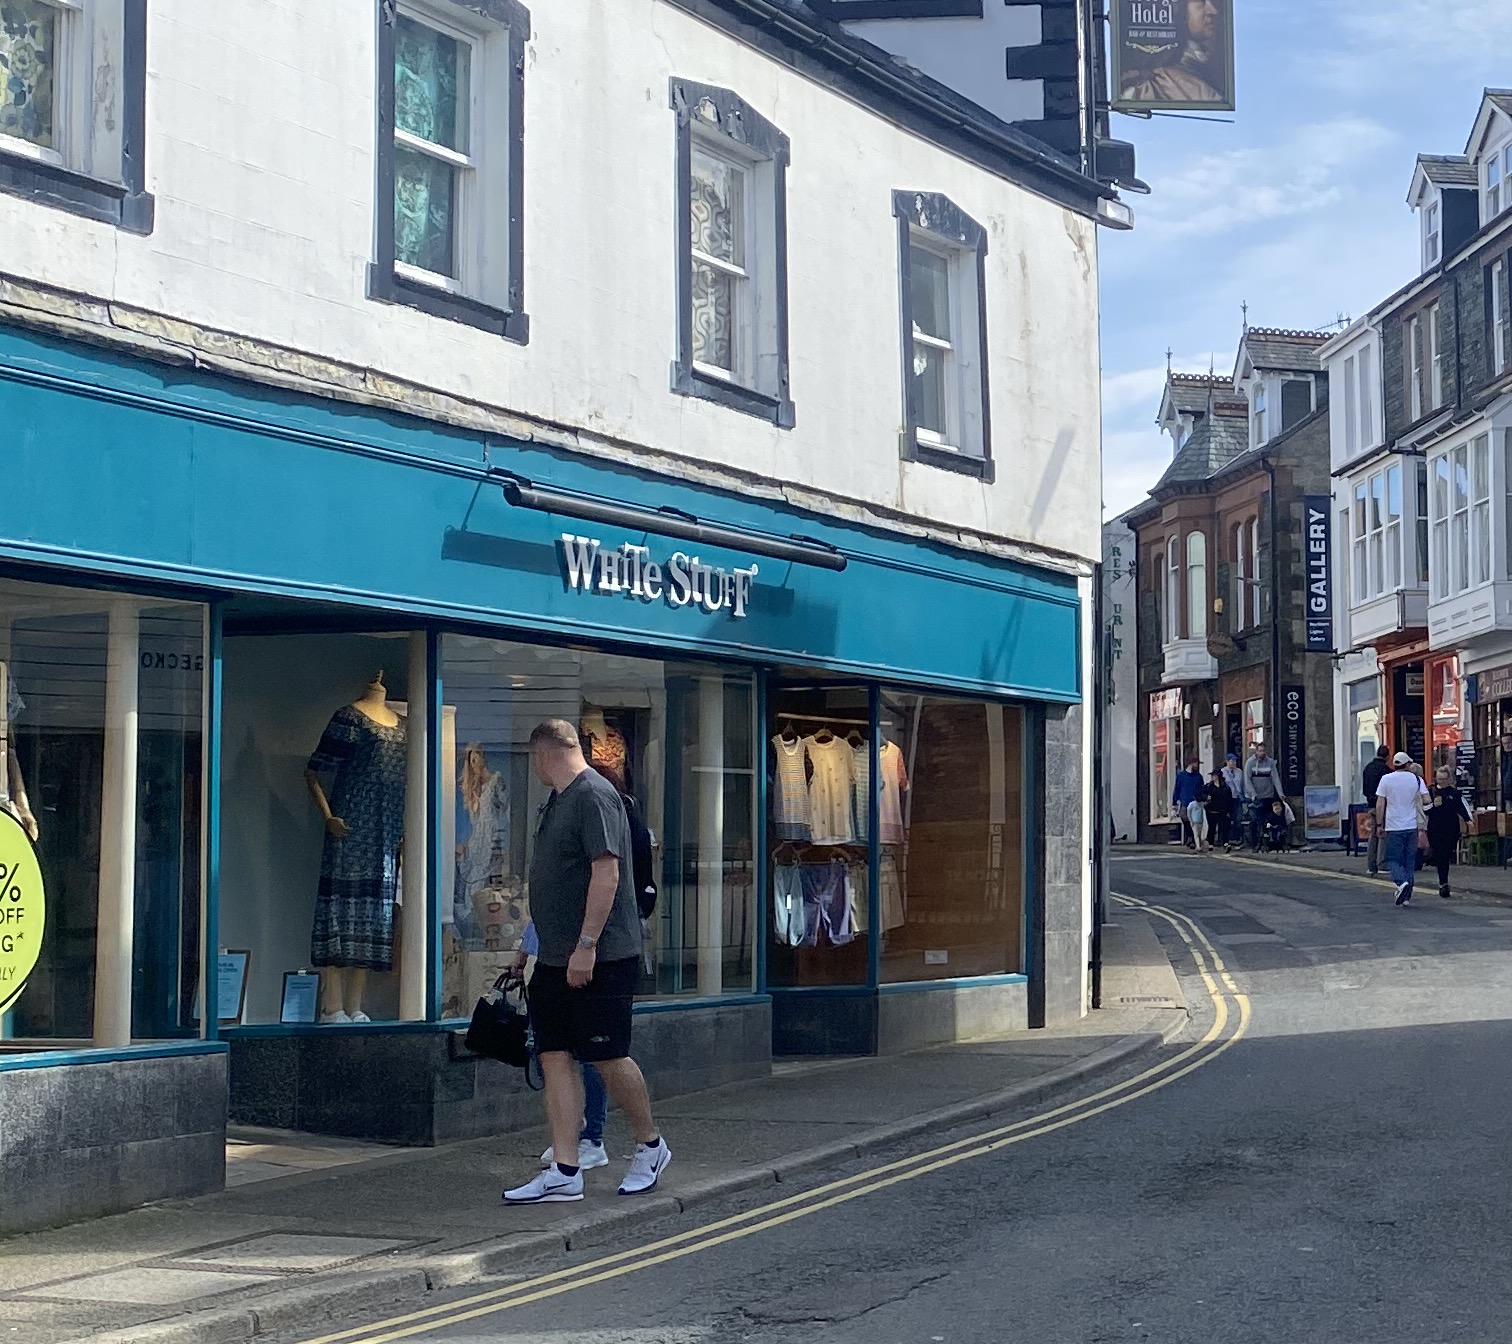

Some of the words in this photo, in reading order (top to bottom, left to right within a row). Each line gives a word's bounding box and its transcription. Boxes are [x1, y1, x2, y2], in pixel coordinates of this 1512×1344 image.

[1131, 3, 1174, 24] Hotel
[1309, 508, 1327, 613] GALLERY
[1287, 691, 1299, 720] eco
